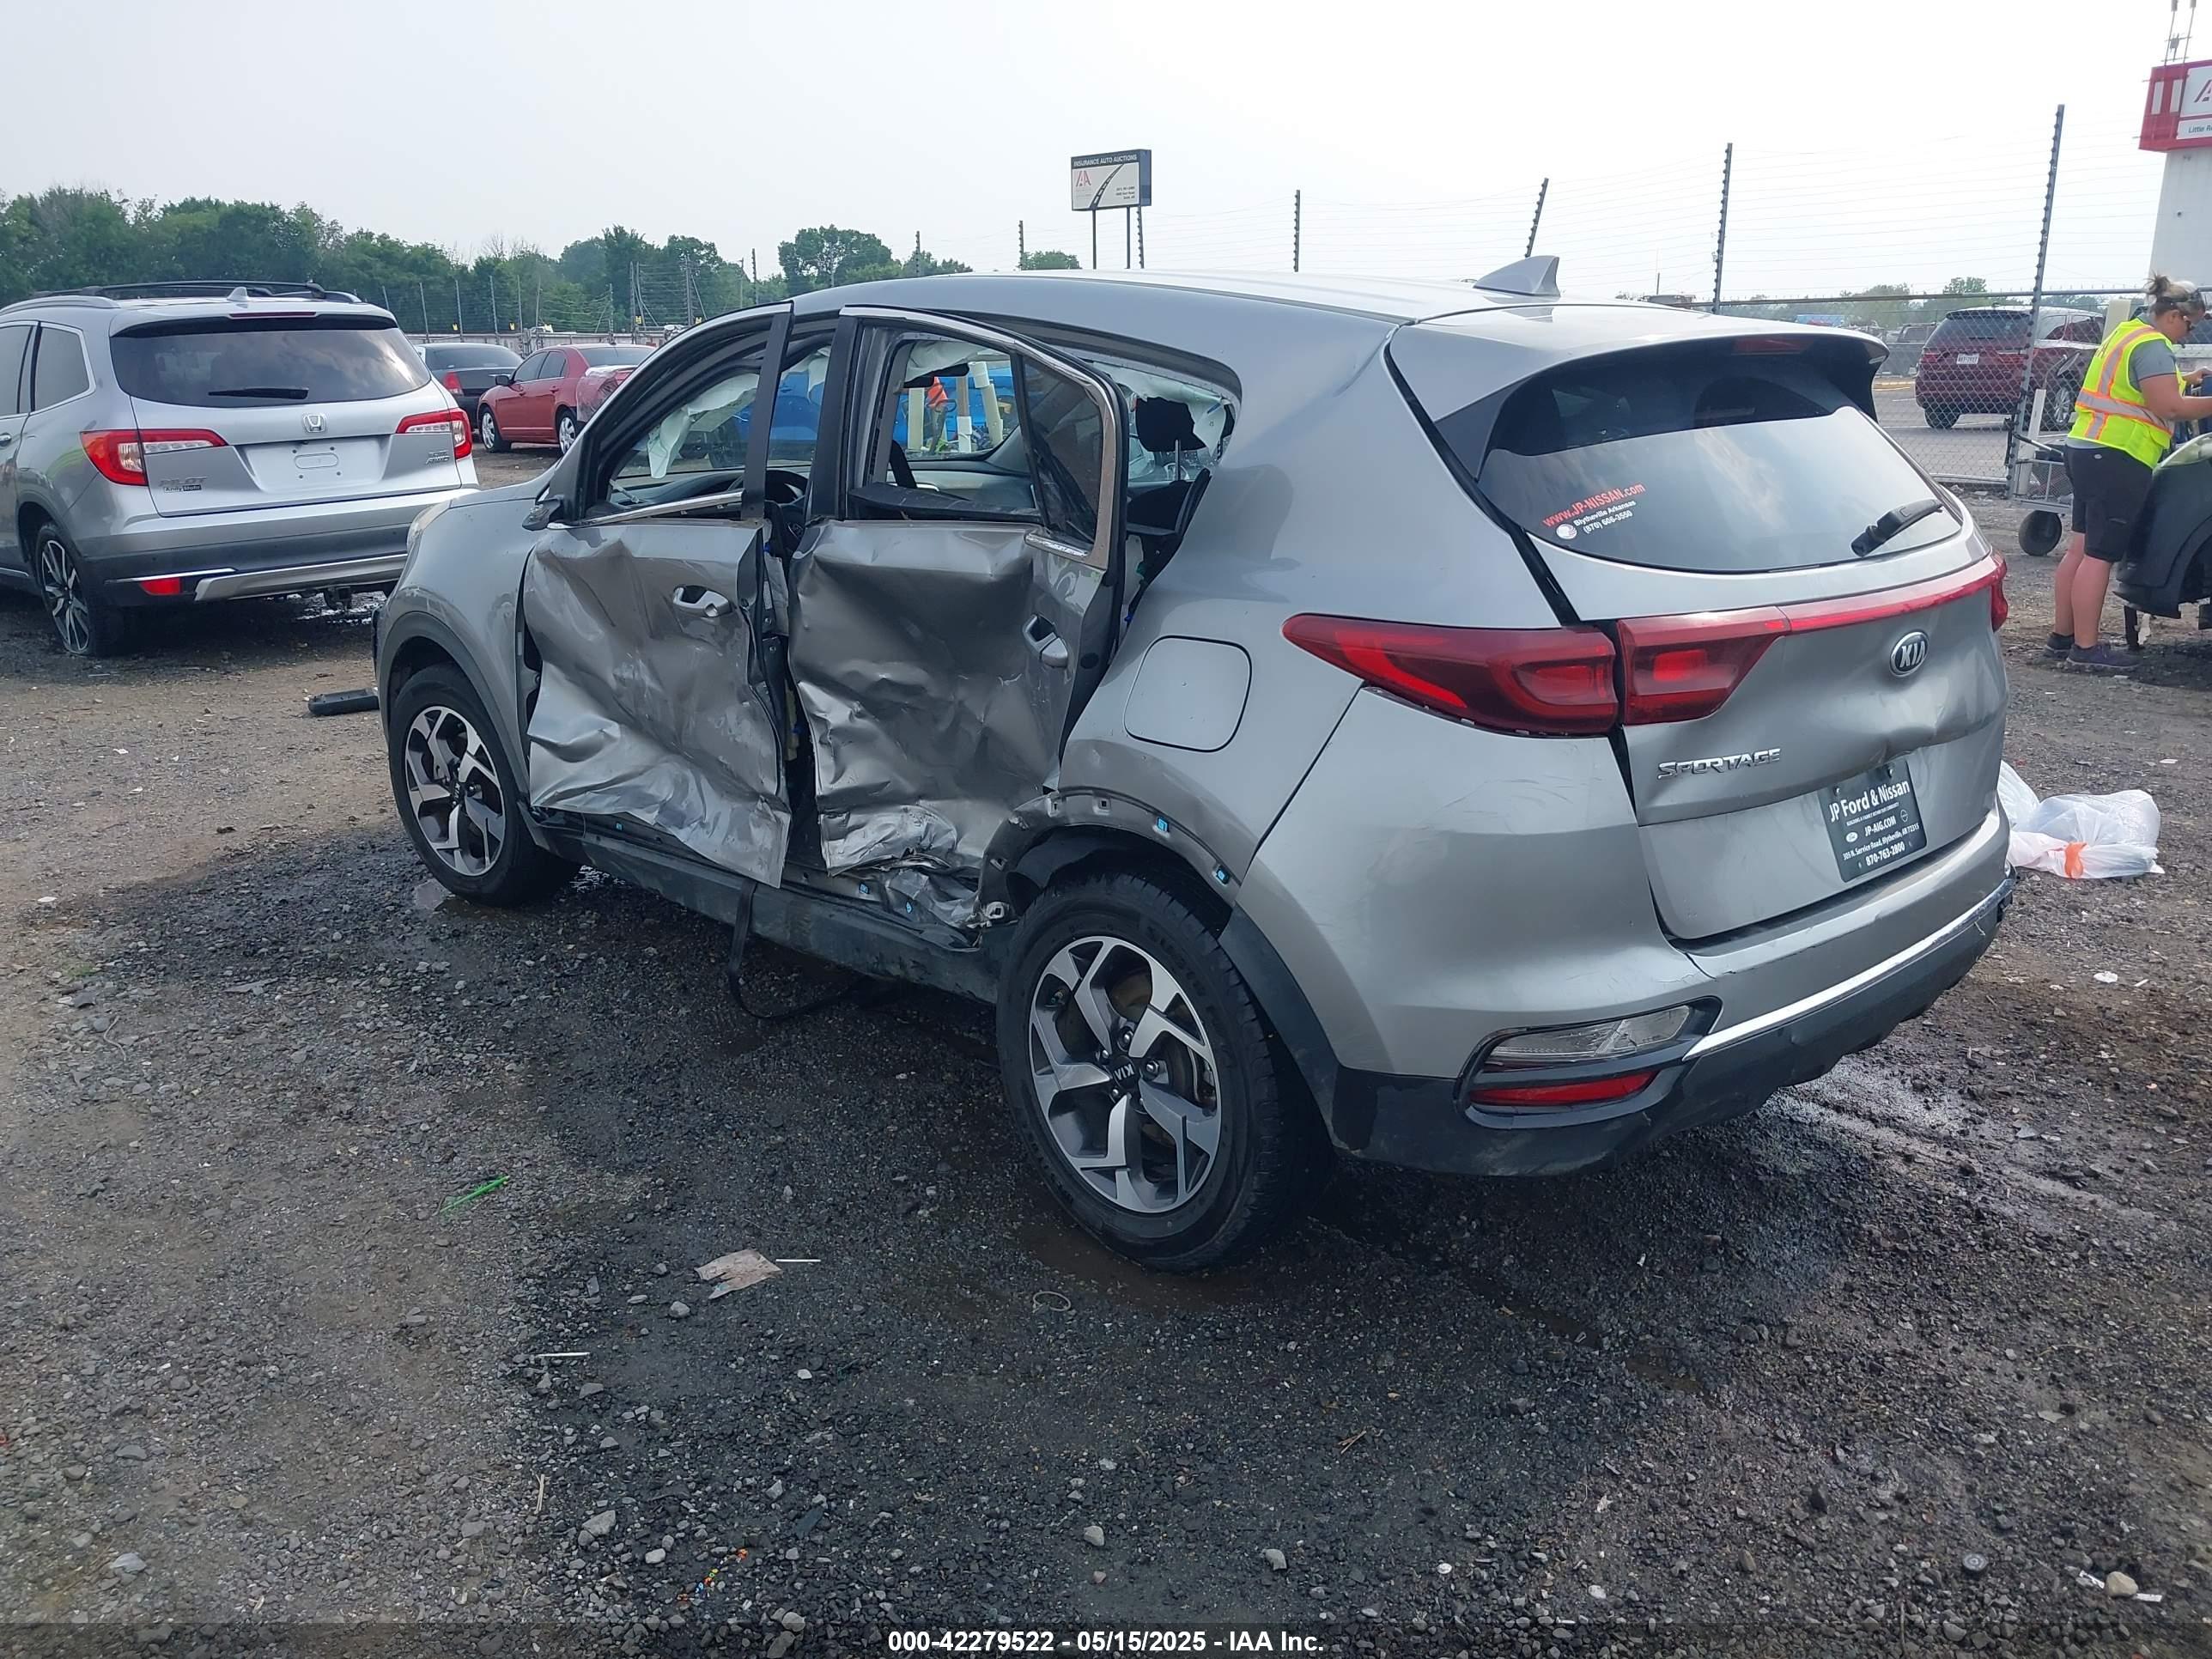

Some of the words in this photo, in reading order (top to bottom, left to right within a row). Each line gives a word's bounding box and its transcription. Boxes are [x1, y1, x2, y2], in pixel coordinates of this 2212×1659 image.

[1583, 520, 1603, 534] (870)
[1899, 641, 1926, 668] KIA
[1657, 747, 1782, 780] SPORTAGE
[1828, 802, 1840, 823] JP
[1840, 791, 1870, 817] Ford
[1869, 789, 1880, 807] &
[1878, 781, 1910, 803] Nissan
[1864, 815, 1897, 837] JP-AIG.COM
[1865, 841, 1905, 866] 870-763-2800
[1114, 1064, 1134, 1080] KIA
